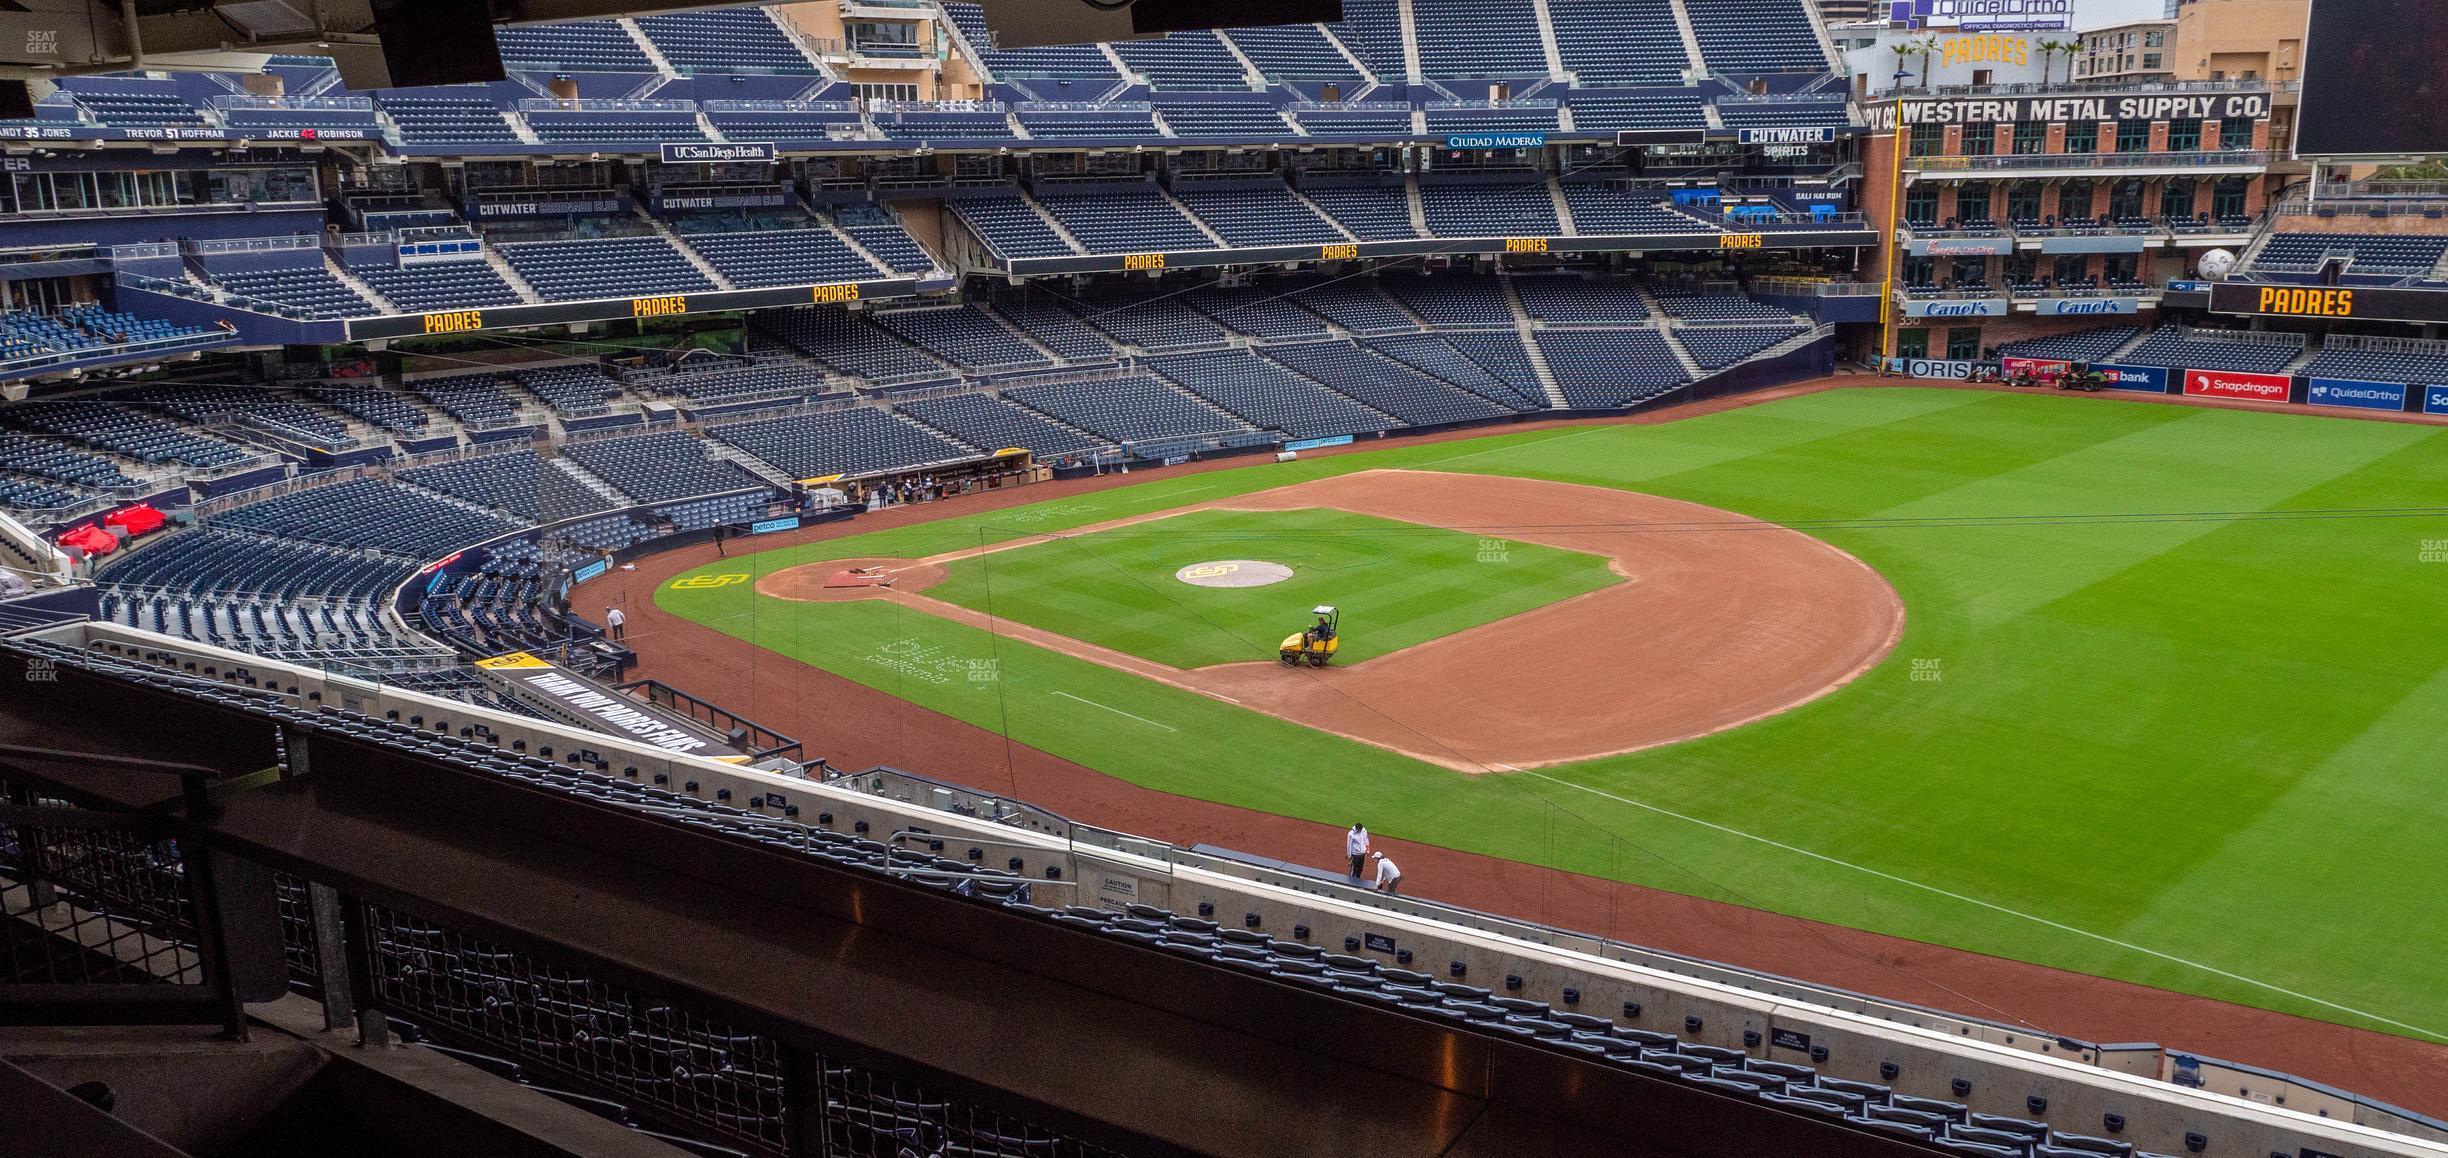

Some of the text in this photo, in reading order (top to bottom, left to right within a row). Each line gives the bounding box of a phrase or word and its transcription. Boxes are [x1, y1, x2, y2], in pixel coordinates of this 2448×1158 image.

[1939, 0, 2066, 18] QuidelOrtho
[1992, 22, 2033, 30] DIAGNOSTICS
[1943, 34, 2028, 68] PADRES
[1902, 95, 2268, 123] WESTERN METAL SUPPLY CO.
[24, 127, 39, 138] 35
[41, 128, 71, 138] JONES
[125, 128, 225, 139] TREVOR 51 HOFFMAN
[266, 129, 363, 139] JACKIE 42 ROBINSON
[1750, 129, 1823, 142] CUTWATER
[1450, 136, 1543, 147] CIUDAD MADERAS
[674, 146, 765, 160] UC San Diego Health
[1763, 146, 1808, 156] SPIRITS
[480, 204, 536, 216] CUTWATER
[663, 198, 712, 209] CUTWATER
[1506, 238, 1547, 252] PADRES
[1720, 234, 1762, 248] PADRES
[1322, 243, 1358, 259] PADRES
[1124, 254, 1165, 269] PADRES
[814, 284, 859, 302] PADRES
[633, 296, 687, 316] PADRES
[2055, 299, 2120, 315] Canel's
[2259, 287, 2353, 316] PADRES
[1925, 302, 1988, 317] Canel's
[424, 311, 482, 333] PADRES
[1912, 361, 1969, 378] ORIS
[2120, 370, 2150, 383] bank
[2213, 378, 2283, 395] Snapdragon
[2330, 387, 2400, 402] QuidelOrtho
[754, 522, 775, 532] petco
[522, 671, 710, 751] THANK YOU PADRES FANS
[1104, 878, 1132, 889] CAUTION
